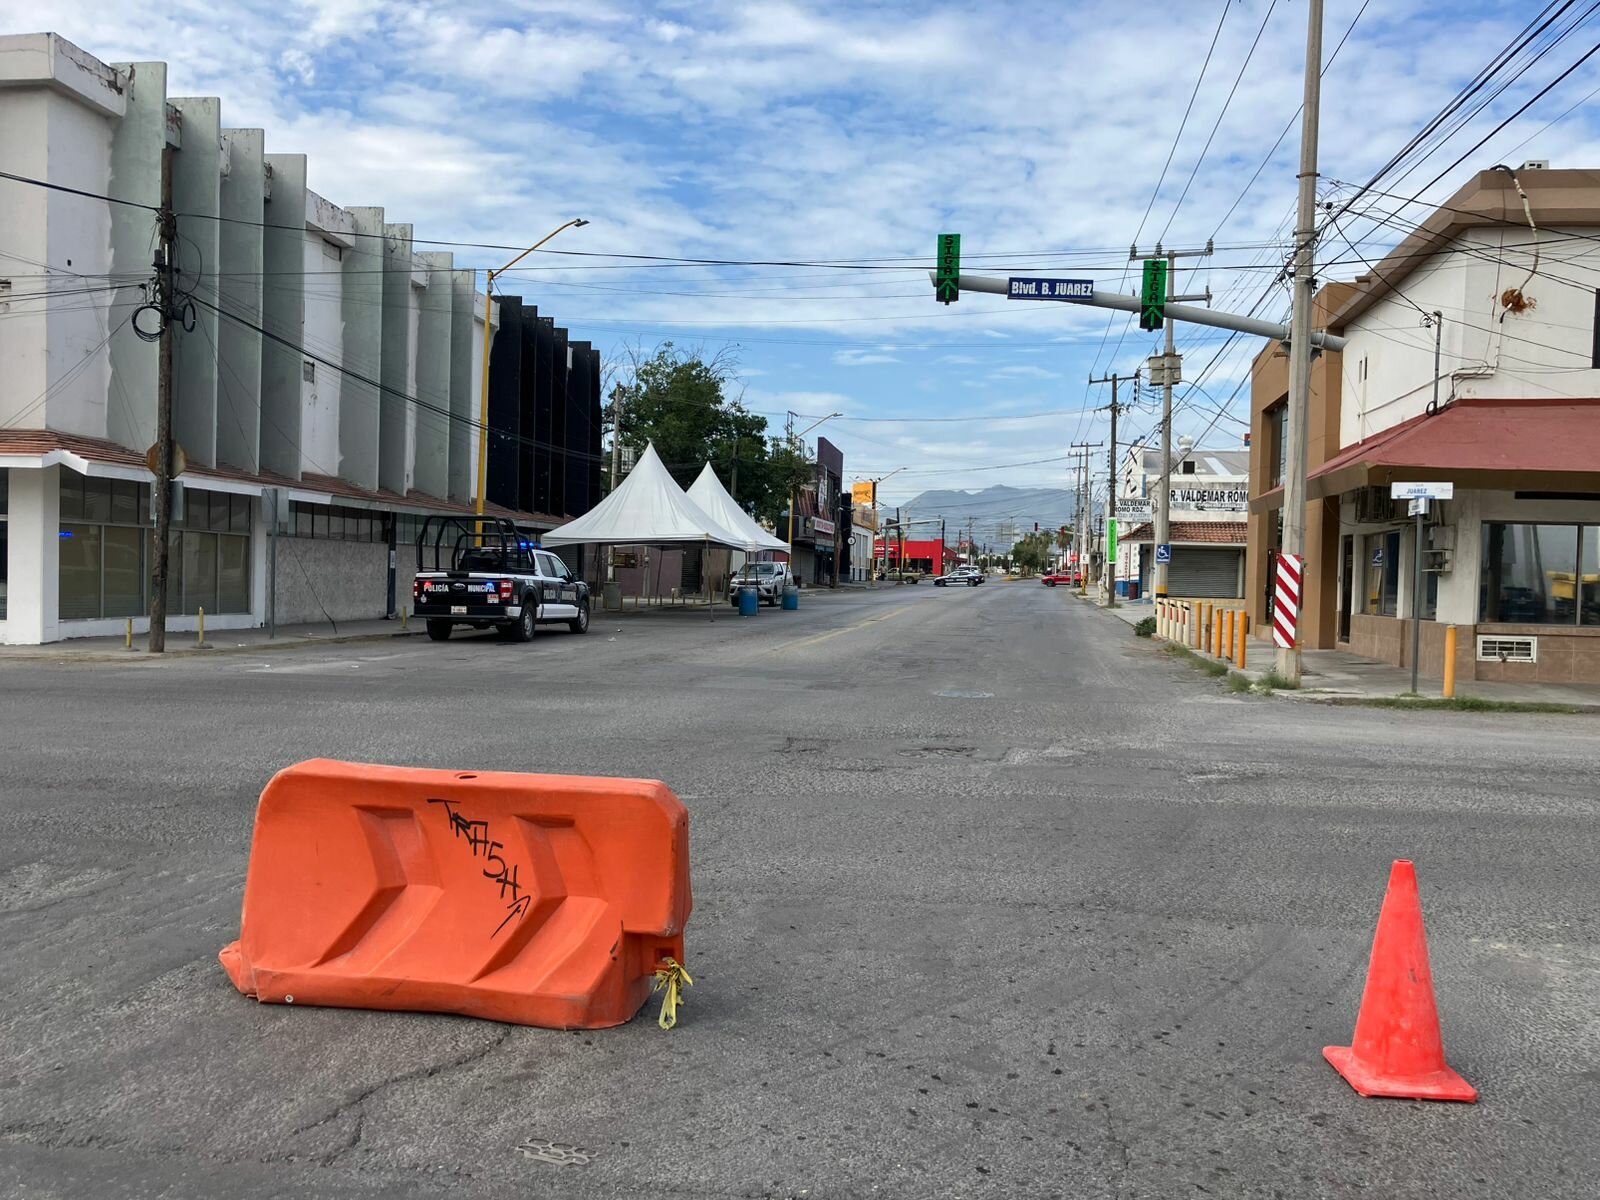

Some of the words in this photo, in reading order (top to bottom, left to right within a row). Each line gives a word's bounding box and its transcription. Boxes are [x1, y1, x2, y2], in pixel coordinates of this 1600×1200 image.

[1011, 281, 1038, 295] Blvd.
[1042, 282, 1052, 295] B.
[1180, 490, 1226, 503] VALDEMAR
[1227, 490, 1249, 503] ROM
